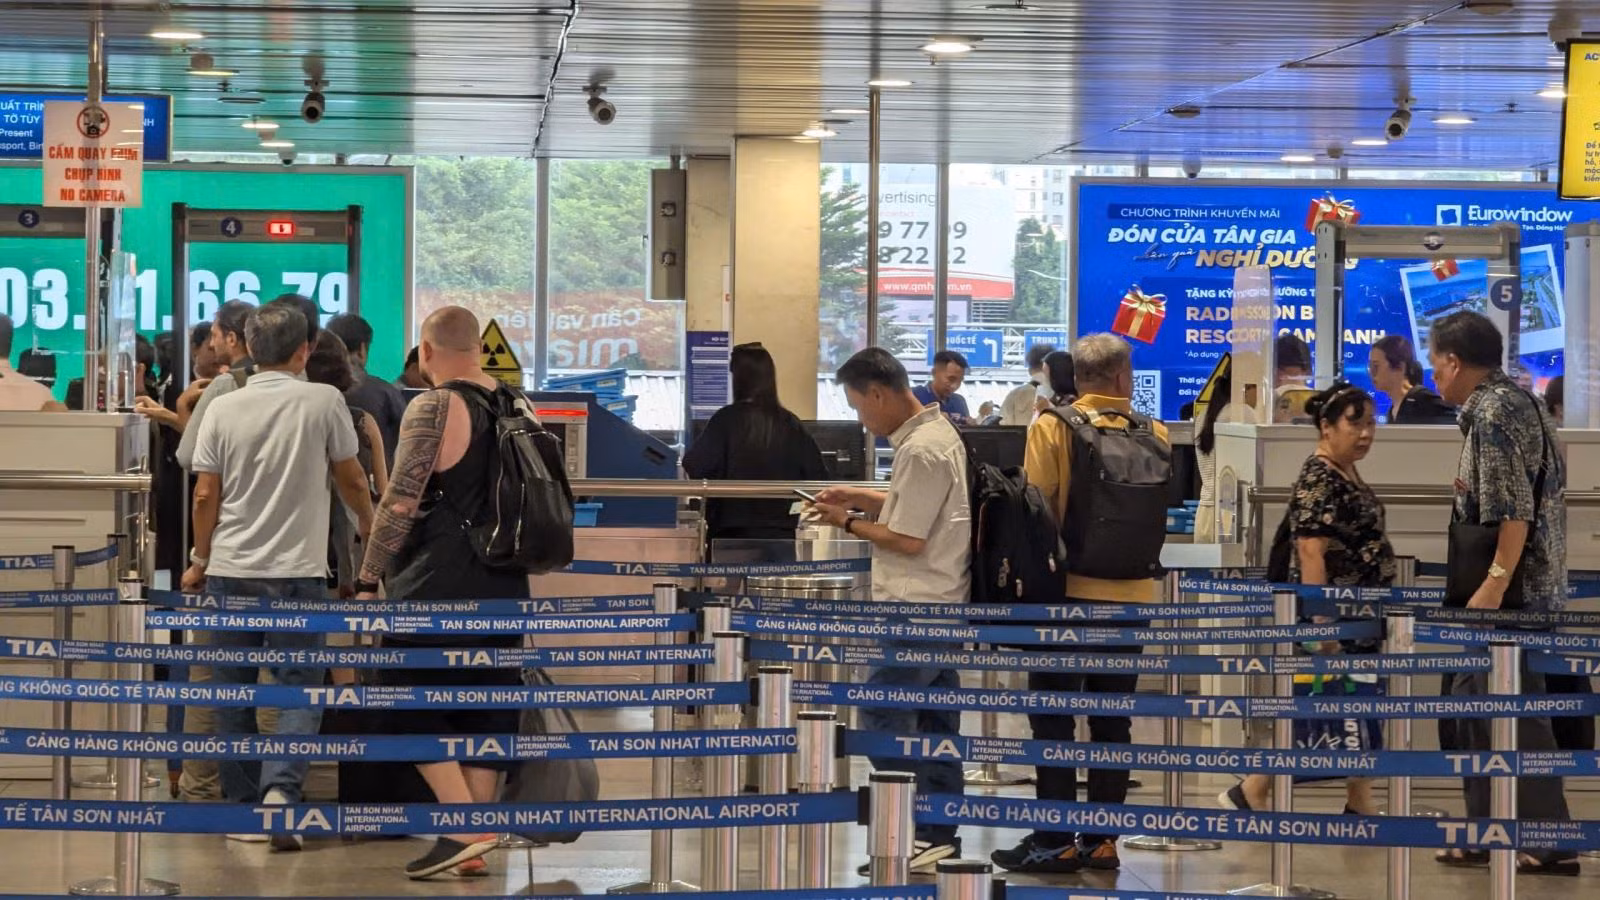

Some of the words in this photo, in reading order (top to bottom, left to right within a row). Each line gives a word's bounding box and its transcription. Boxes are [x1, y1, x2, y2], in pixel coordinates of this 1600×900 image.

[49, 143, 73, 159] CẤM
[78, 147, 107, 161] QUAY
[65, 168, 93, 183] CHỤP
[97, 166, 121, 180] HÌNH
[60, 189, 75, 201] NO
[79, 189, 125, 202] CAMERA
[24, 213, 34, 224] 3
[1120, 207, 1171, 218] CHƯƠNG
[1173, 206, 1208, 218] TRÌNH
[1210, 206, 1257, 219] KHUYẾN
[1259, 206, 1281, 219] MÃI
[1468, 205, 1573, 222] Eurowindow
[226, 221, 236, 234] 4
[1108, 225, 1156, 244] ĐÓN
[1160, 222, 1207, 244] CỬA
[1212, 226, 1258, 245] TÂN
[1259, 229, 1297, 245] GIA
[1195, 243, 1261, 268] NGHỈ
[1185, 288, 1216, 300] TẶNG
[1500, 284, 1514, 300] 5
[165, 610, 201, 627] QUỐC
[202, 612, 219, 627] TẾ
[220, 614, 245, 627] TÂN
[247, 616, 274, 629] SƠN
[275, 614, 308, 628] NHẤT
[343, 617, 391, 632] TIA
[439, 619, 464, 630] TAN
[465, 619, 491, 630] SON
[492, 619, 525, 630] NHAT
[526, 618, 618, 630] INTERNATIONAL
[619, 617, 671, 629] AIRPORT
[19, 678, 73, 696] KHÔNG
[76, 679, 120, 698] QUỐC
[123, 681, 143, 698] TẾ
[146, 682, 176, 699] TÂN
[179, 686, 212, 701] SƠN
[215, 686, 257, 701] NHẤT
[303, 687, 361, 706] TIA
[424, 690, 453, 703] TAN
[456, 691, 488, 703] SON
[491, 690, 530, 704] NHAT
[533, 689, 649, 704] INTERNATIONAL
[650, 687, 716, 701] AIRPORT
[846, 687, 885, 702] CẢNG
[887, 689, 926, 704] HÀNG
[928, 689, 977, 706] KHÔNG
[979, 692, 1018, 707] QUỐC
[1020, 689, 1038, 707] TẾ
[1039, 693, 1067, 709] TÂN
[1069, 696, 1099, 709] SƠN
[1101, 696, 1137, 710] NHẤT
[1184, 698, 1243, 717] TIA
[1313, 702, 1340, 713] TAN
[1343, 701, 1372, 714] SON
[1375, 702, 1411, 713] NHAT
[1414, 700, 1522, 713] INTERNATIONAL
[1523, 699, 1584, 711] AIRPORT
[25, 733, 71, 750] CẢNG
[74, 736, 119, 751] HÀNG
[122, 738, 179, 754] KHÔNG
[181, 737, 227, 753] QUỐC
[230, 739, 251, 754] TẾ
[254, 740, 285, 755] TÂN
[288, 741, 322, 755] SƠN
[326, 741, 367, 755] NHẤT
[438, 737, 506, 757] TIA
[588, 738, 619, 752] TAN
[622, 737, 656, 752] SON
[660, 736, 702, 751] NHAT
[895, 735, 962, 759] TIA
[972, 747, 1027, 755] INTERNATIONAL
[1042, 746, 1086, 762] CẢNG
[1090, 748, 1133, 764] HÀNG
[1136, 750, 1192, 767] KHÔNG
[1195, 751, 1240, 769] QUỐC
[1243, 753, 1263, 768] TẾ
[1265, 754, 1297, 768] TÂN
[1300, 754, 1333, 770] SƠN
[1336, 755, 1377, 769] NHẤT
[1444, 754, 1513, 773] TIA
[3, 804, 27, 823] TẾ
[31, 806, 68, 823] TÂN
[72, 807, 112, 824] SƠN
[117, 808, 166, 825] NHẤT
[252, 807, 333, 831] TIA
[344, 815, 410, 824] INTERNATIONAL
[429, 812, 466, 826] TAN
[470, 811, 510, 826] SON
[515, 809, 564, 826] NHAT
[568, 804, 715, 825] INTERNATIONAL
[718, 801, 801, 820] AIRPORT
[944, 801, 1000, 820] CẢNG
[1005, 805, 1061, 824] HÀNG
[1066, 806, 1137, 829] KHÔNG
[1142, 808, 1199, 833] QUỐC
[1204, 811, 1229, 833] TẾ
[1234, 817, 1273, 836] TÂN
[1278, 817, 1321, 838] SƠN
[1326, 818, 1379, 840] NHẤT
[344, 824, 382, 832] AIRPORT
[1436, 821, 1513, 846] TIA
